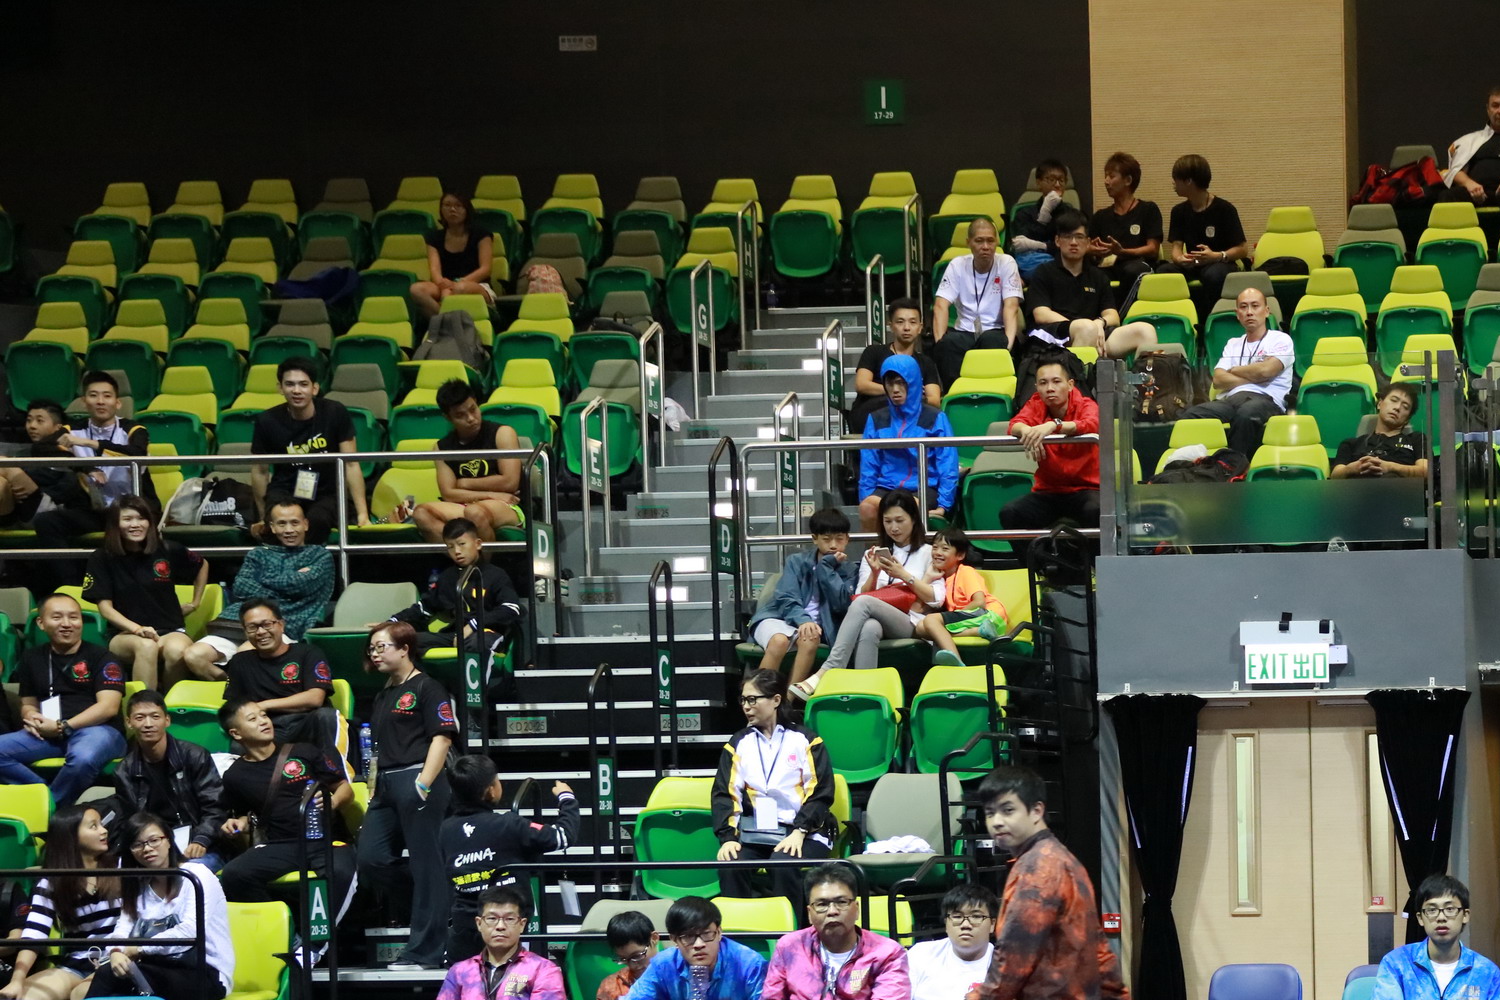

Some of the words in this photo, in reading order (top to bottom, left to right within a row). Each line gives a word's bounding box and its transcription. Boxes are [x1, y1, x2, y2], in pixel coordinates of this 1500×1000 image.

[880, 86, 887, 110] I
[874, 111, 905, 120] 17-29
[744, 241, 752, 268] H
[910, 236, 918, 263] H
[698, 304, 707, 330] G
[872, 300, 881, 327] G
[831, 364, 838, 390] F
[590, 447, 601, 475] E
[538, 529, 549, 559] D
[722, 524, 731, 554] D
[466, 658, 480, 690] C
[658, 655, 670, 686] C
[1248, 653, 1288, 680] EXIT
[1293, 653, 1327, 680] 出口
[599, 764, 612, 796] B
[454, 847, 497, 868] CHINA
[310, 886, 328, 921] A
[310, 924, 329, 935] 20-25
